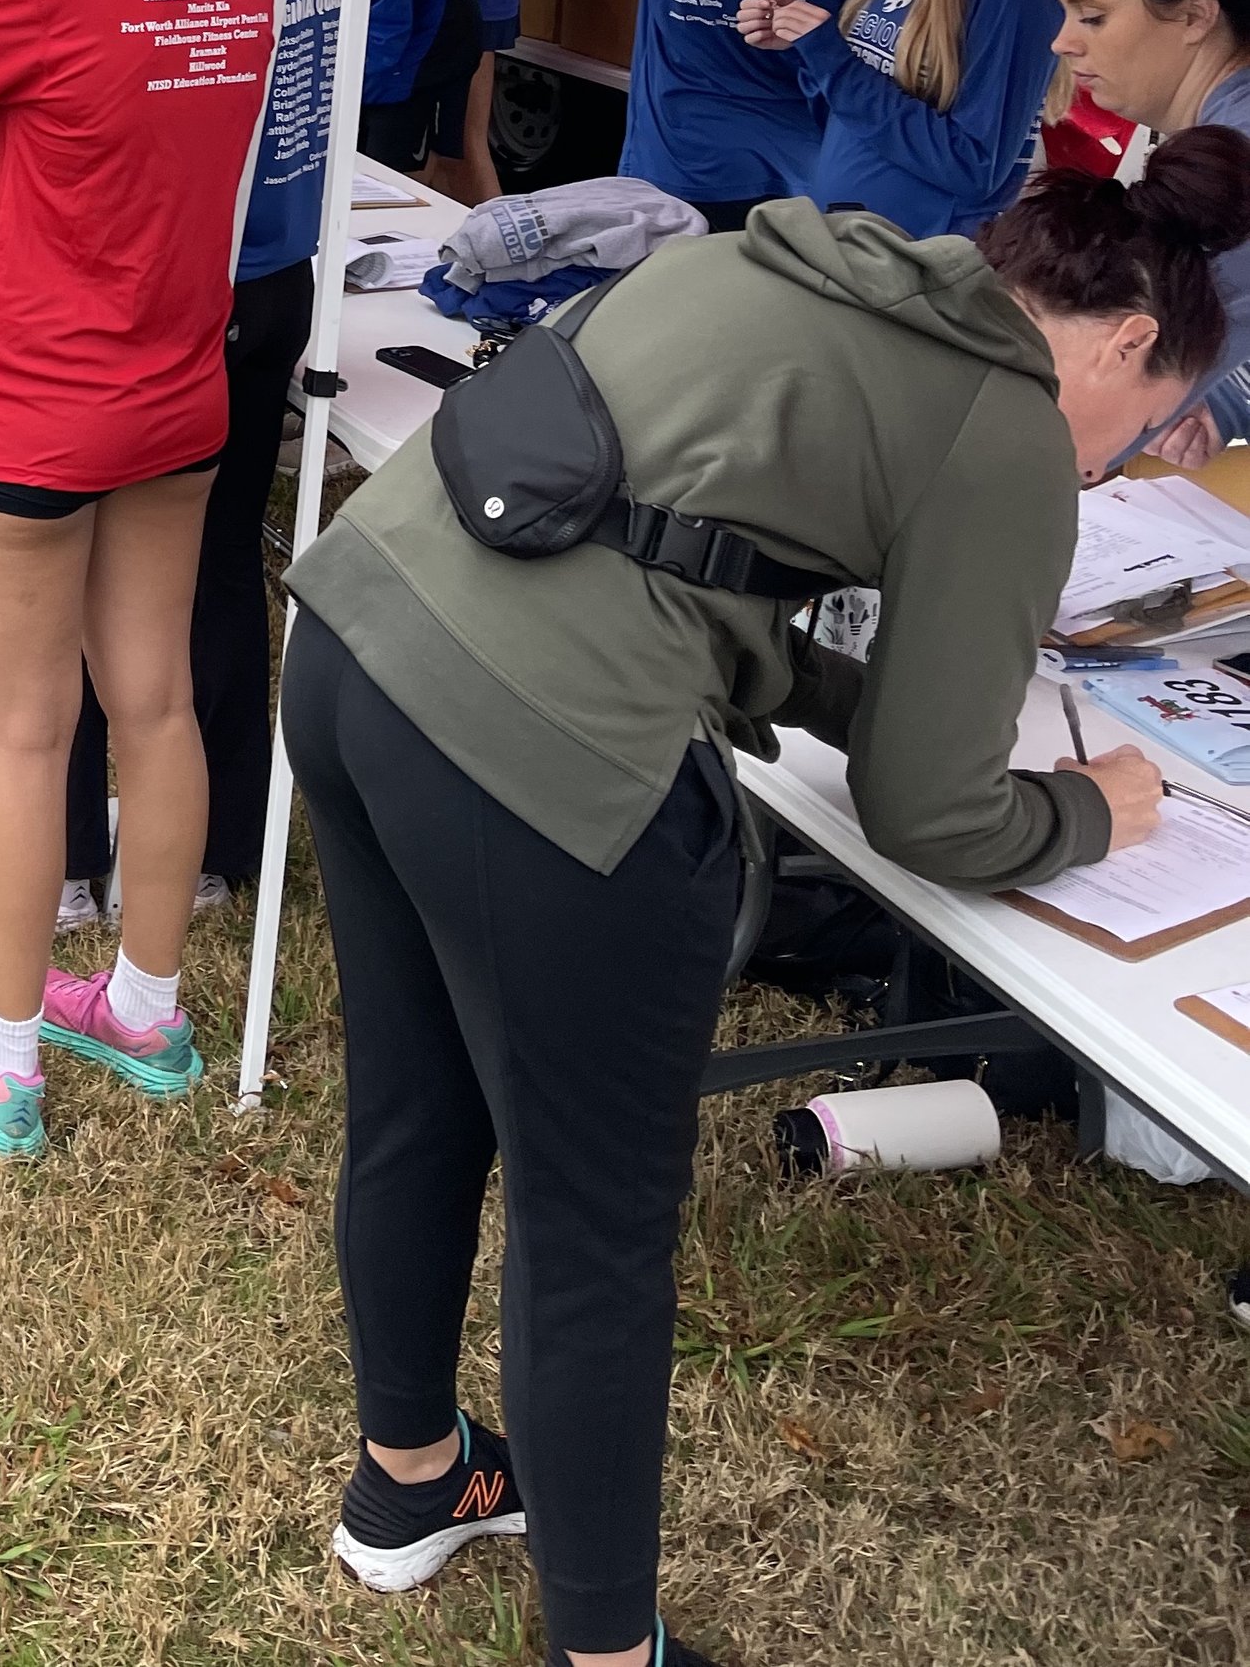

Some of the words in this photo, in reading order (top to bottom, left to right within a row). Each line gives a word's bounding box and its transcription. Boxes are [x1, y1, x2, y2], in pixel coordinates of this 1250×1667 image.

[187, 3, 215, 13] Moritz
[215, 1, 231, 11] Kia
[120, 22, 145, 33] Fort
[145, 20, 173, 31] Worth
[174, 18, 209, 30] Alliance
[210, 16, 240, 28] Airport
[154, 35, 202, 47] Fieldhouse
[202, 31, 233, 42] Fitness
[234, 29, 259, 40] Center
[189, 45, 227, 58] Aramark
[189, 60, 226, 73] Hillwood
[147, 80, 172, 92] NISD
[173, 76, 216, 89] Education
[453, 1471, 504, 1517] N
